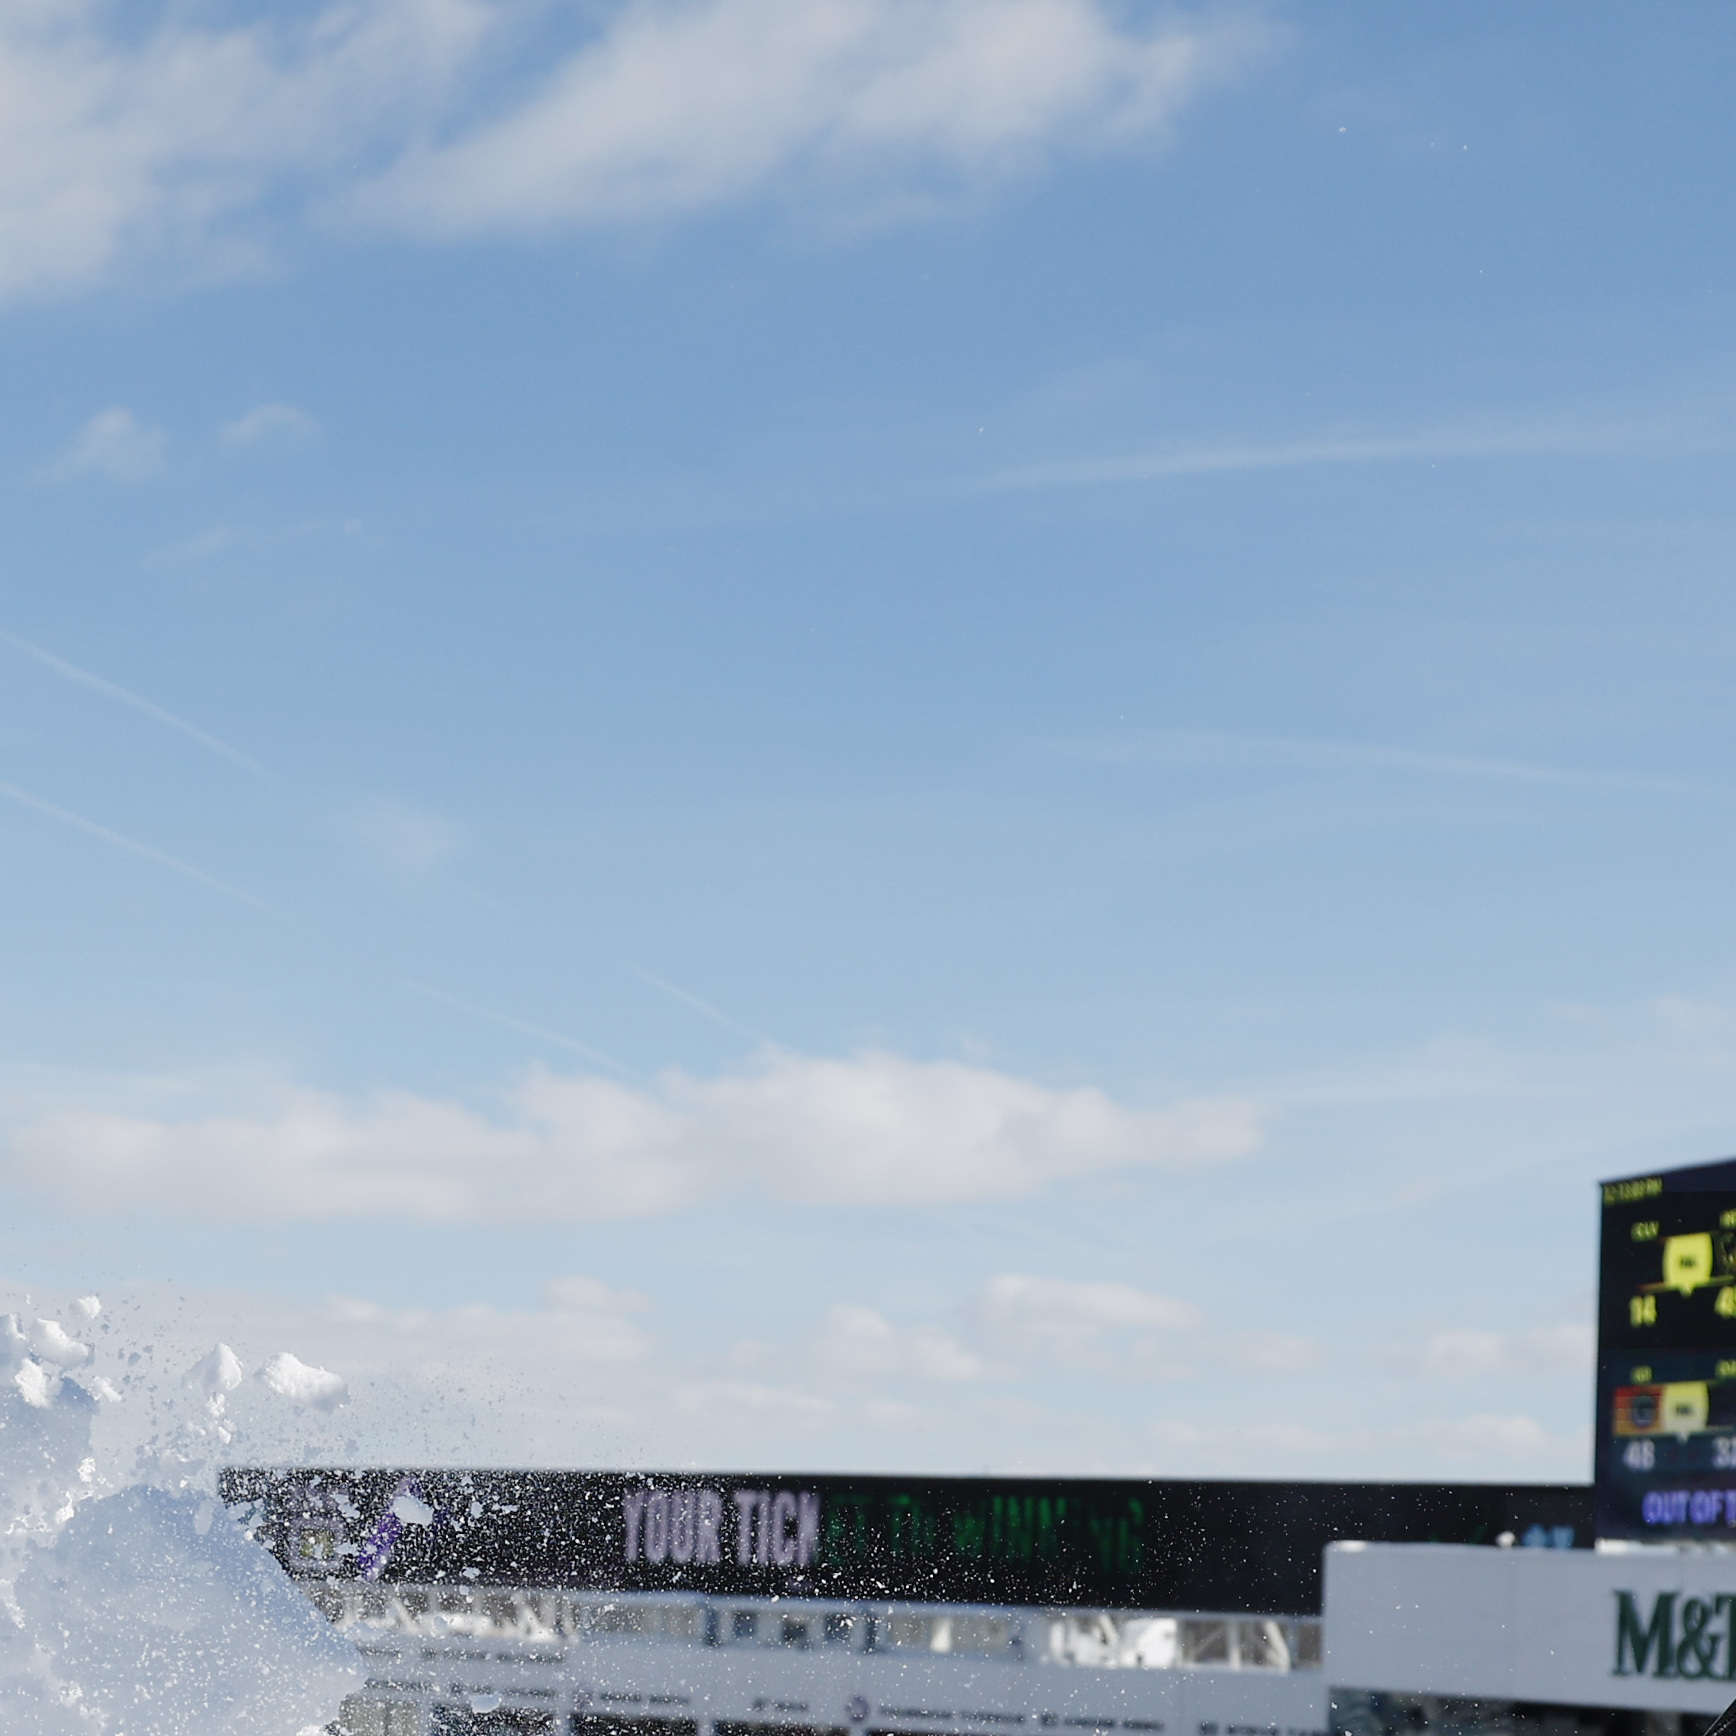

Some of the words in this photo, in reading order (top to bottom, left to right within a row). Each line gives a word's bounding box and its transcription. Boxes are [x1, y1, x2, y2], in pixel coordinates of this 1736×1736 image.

[624, 1489, 721, 1565] YOUR
[1644, 1491, 1689, 1523] OUT
[1690, 1489, 1724, 1524] OF
